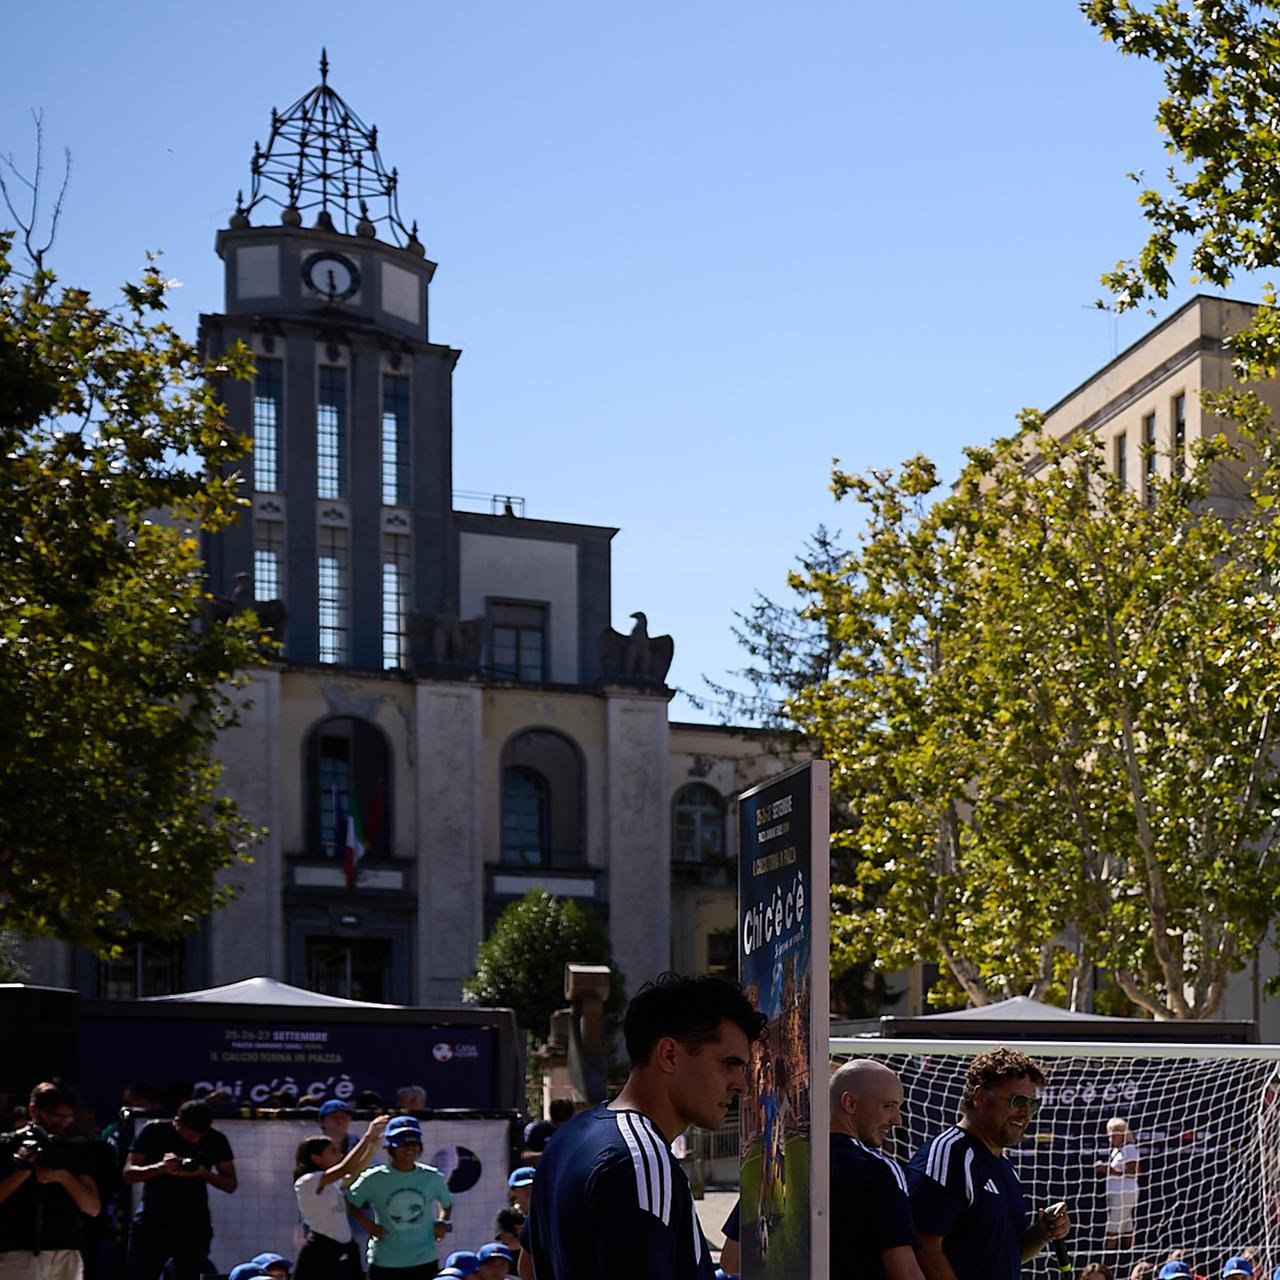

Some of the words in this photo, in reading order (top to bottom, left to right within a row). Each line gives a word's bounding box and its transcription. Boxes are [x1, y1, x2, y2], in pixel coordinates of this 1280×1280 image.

[744, 901, 763, 956] Chi
[765, 884, 783, 943] c'è
[785, 869, 804, 930] c'è
[273, 1030, 328, 1042] SETTEMBRE
[250, 1075, 299, 1103] c'è
[306, 1073, 354, 1100] c'è
